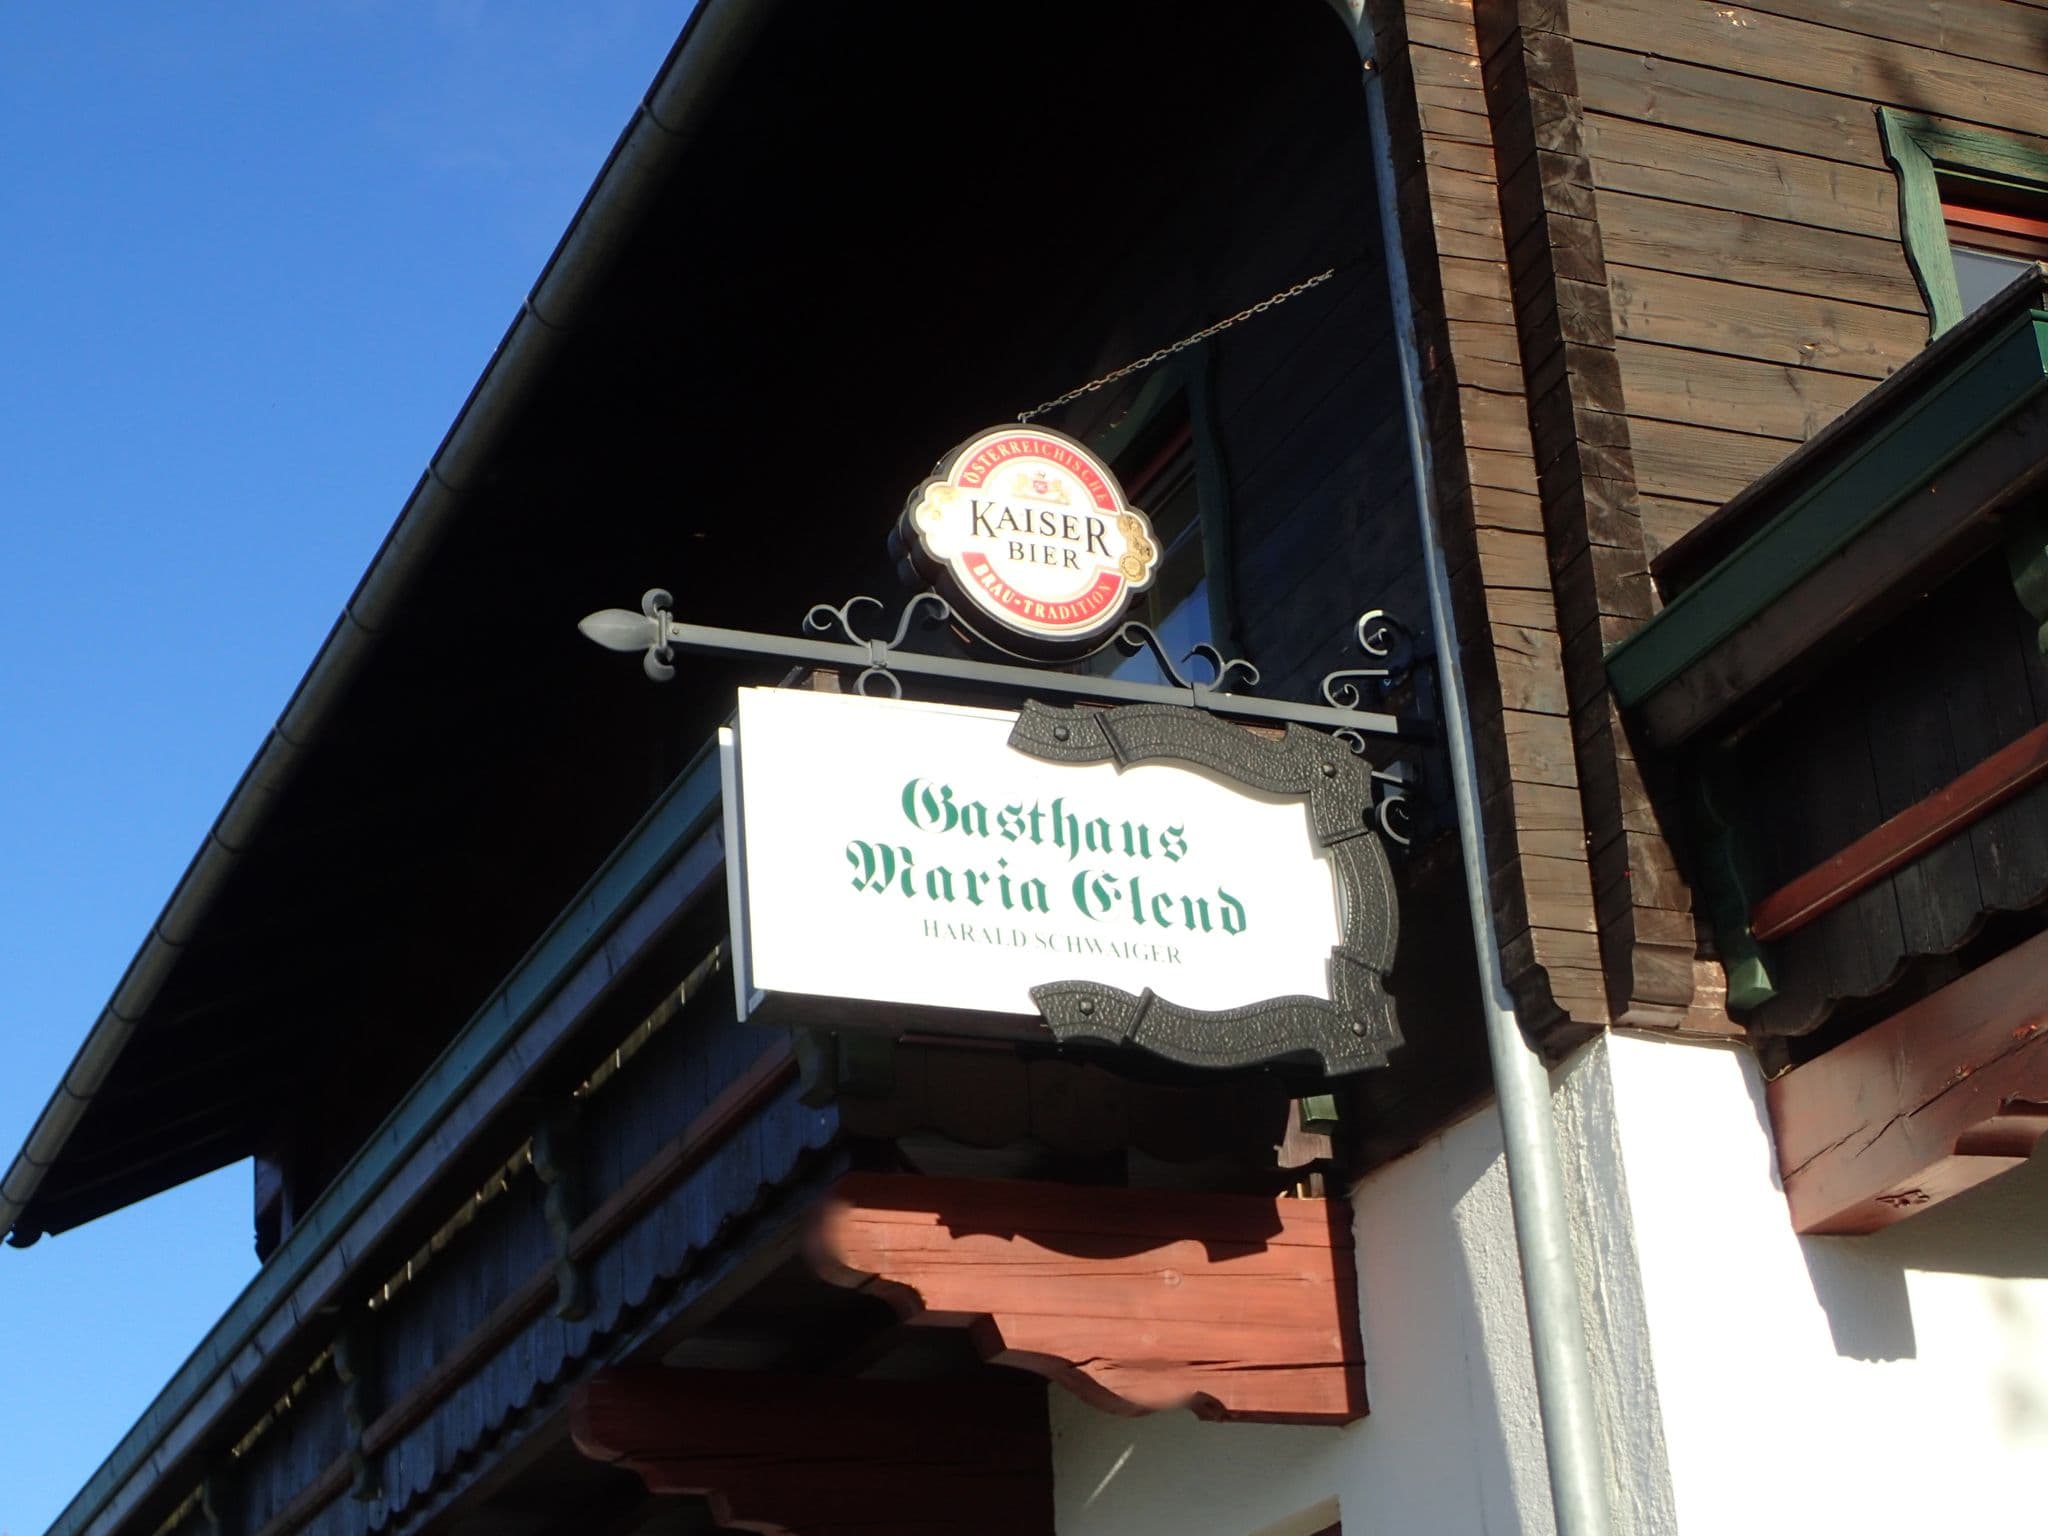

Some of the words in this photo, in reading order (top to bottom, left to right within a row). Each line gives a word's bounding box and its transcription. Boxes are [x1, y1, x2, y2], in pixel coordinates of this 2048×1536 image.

[970, 499, 1112, 558] KAISER
[1008, 541, 1081, 570] BIER
[901, 777, 1188, 863] Gasthaus
[846, 839, 1050, 914] Maria
[1072, 869, 1248, 936] Elend
[923, 919, 1027, 948] HARALD
[1034, 932, 1183, 965] SCHWAIGER
